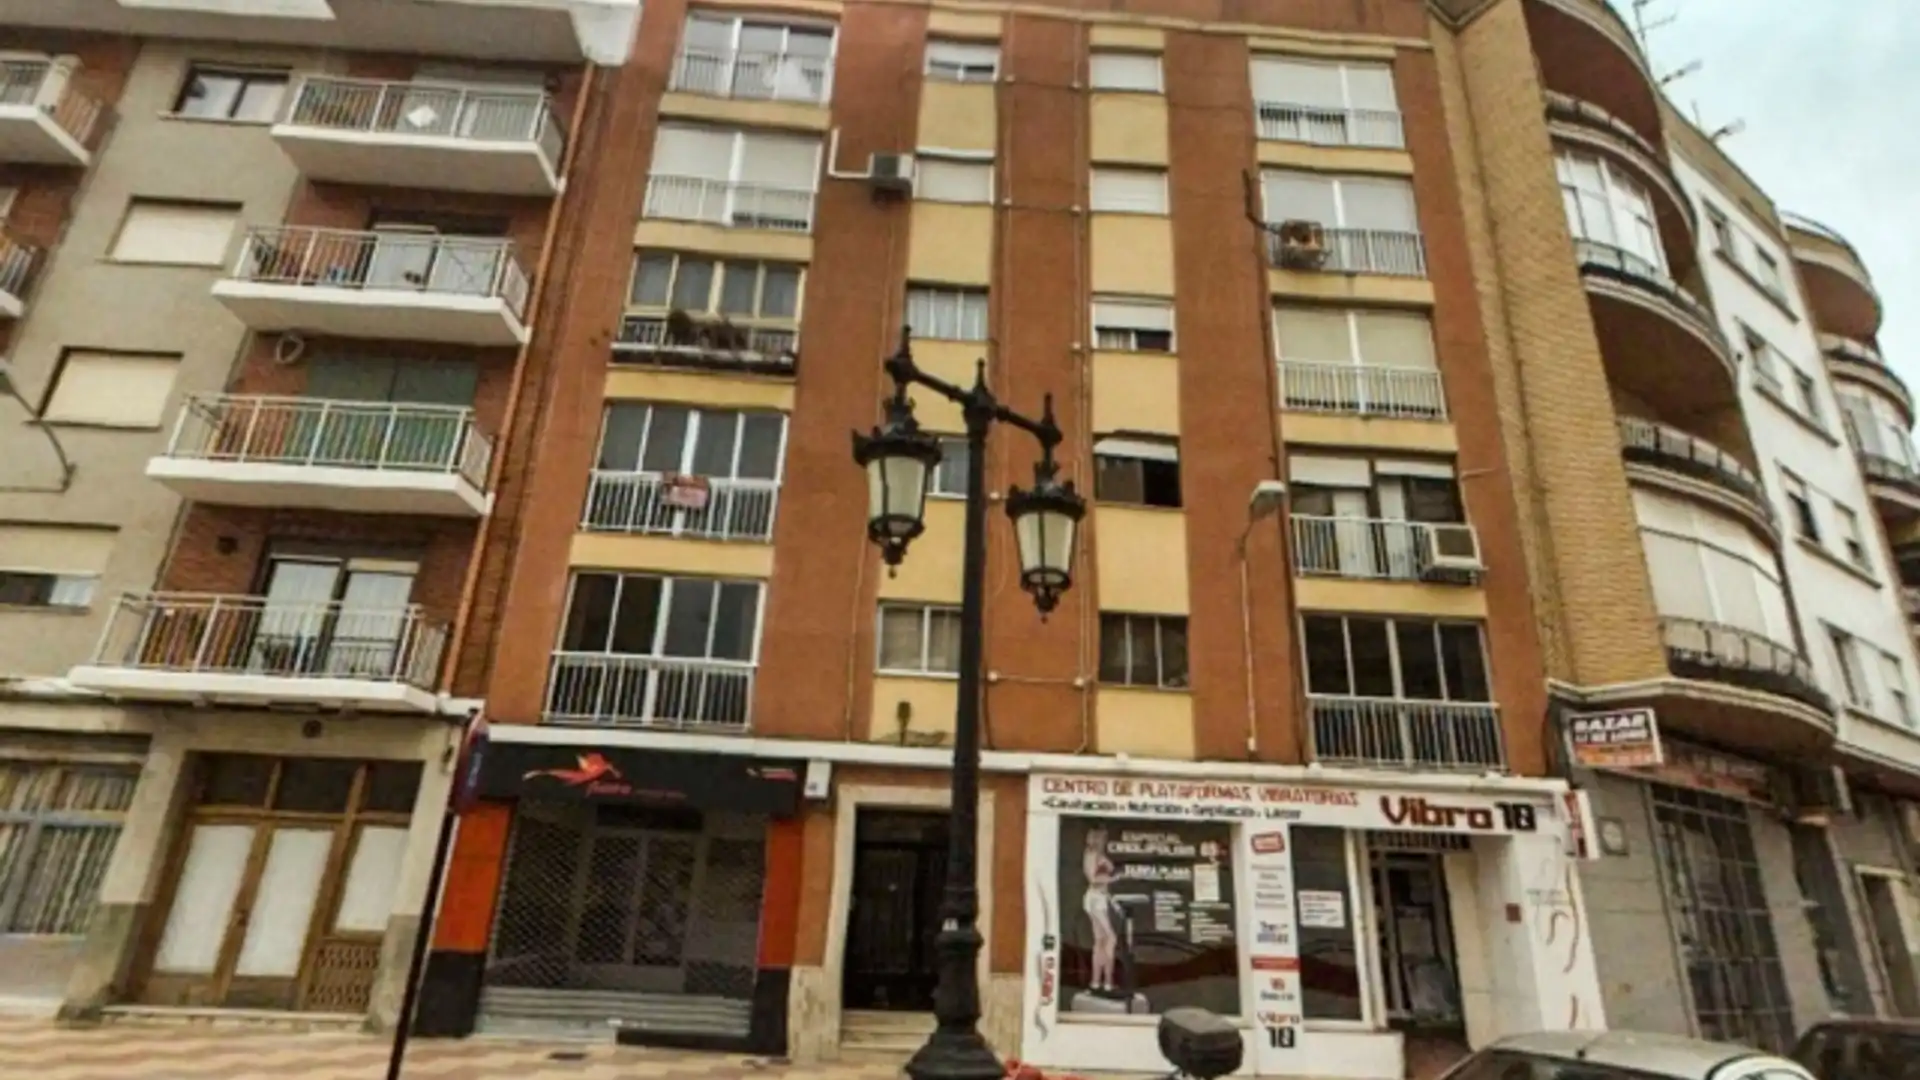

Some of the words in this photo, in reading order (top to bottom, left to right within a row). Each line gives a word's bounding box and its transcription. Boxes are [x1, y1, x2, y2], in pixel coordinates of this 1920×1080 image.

[1043, 777, 1107, 796] CENTRO
[1113, 779, 1133, 796] DE
[1140, 782, 1251, 801] PLATAFORMAS
[1257, 784, 1358, 806] VIBRATORIAS
[1380, 795, 1493, 829] Vibro
